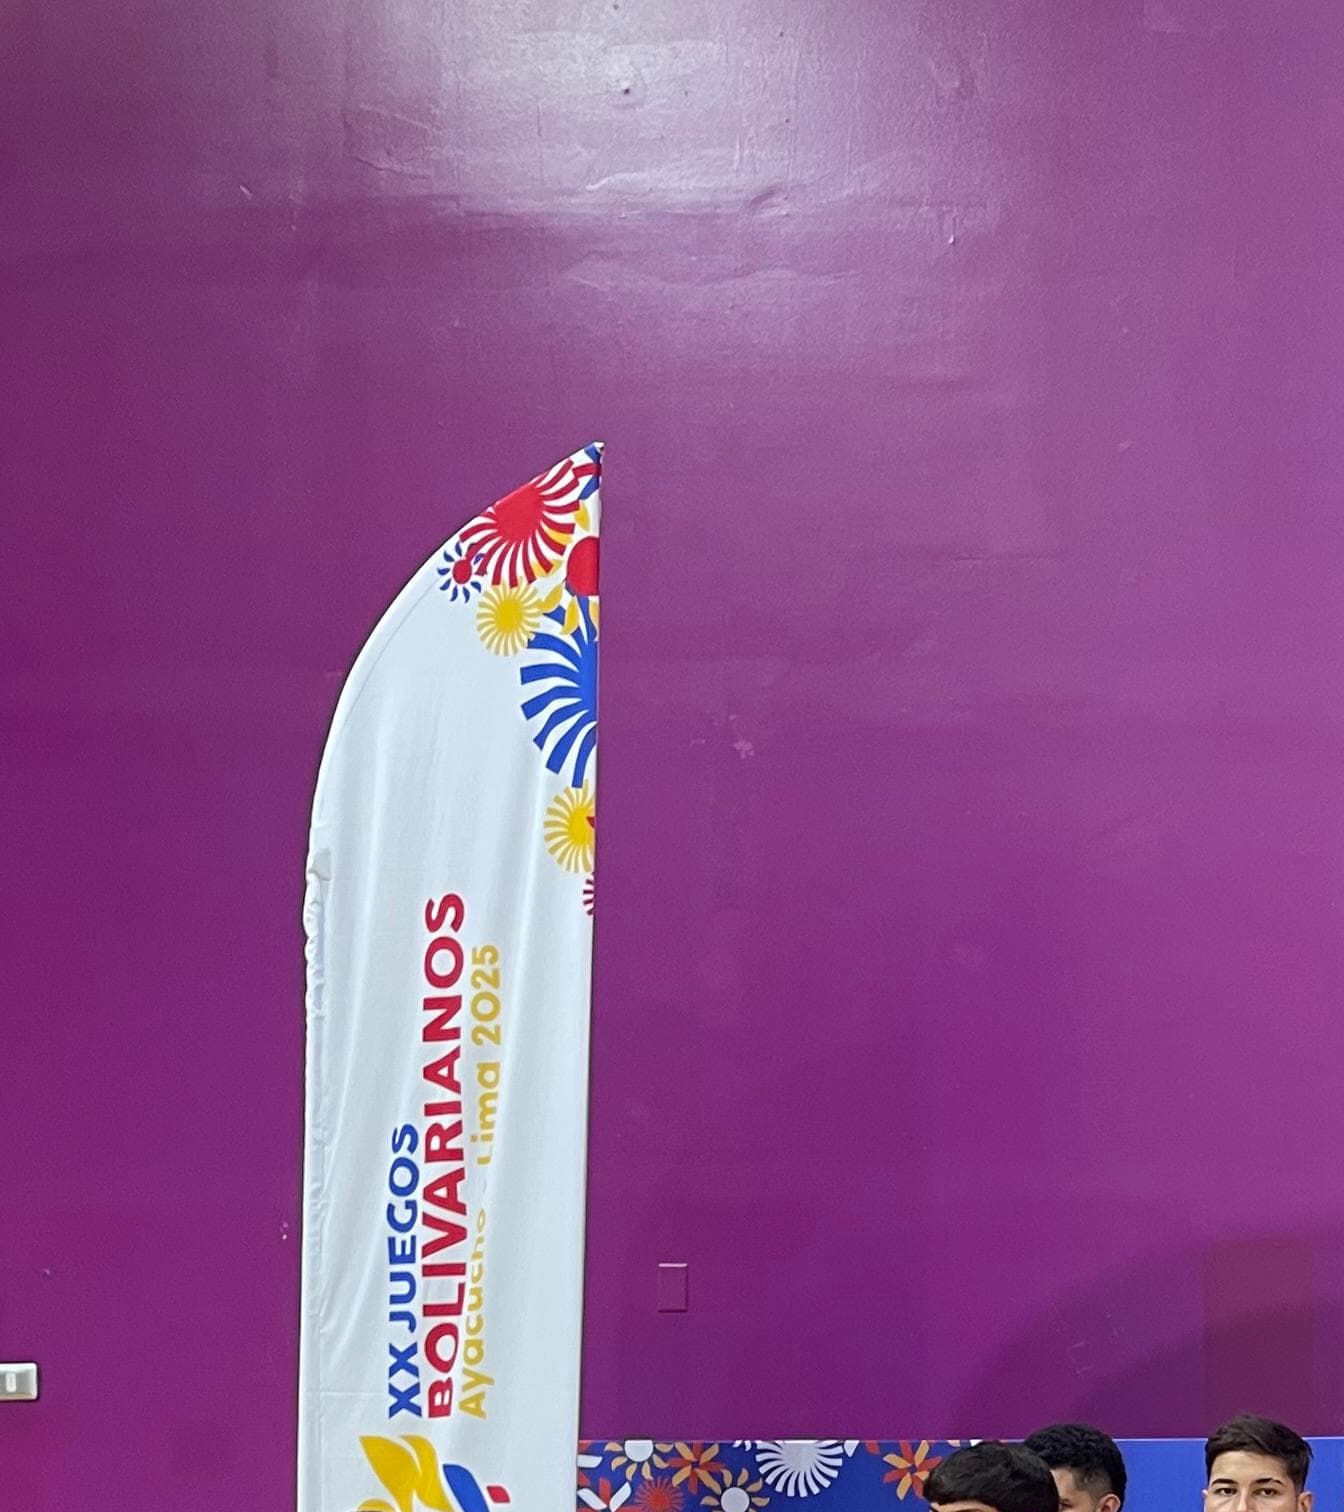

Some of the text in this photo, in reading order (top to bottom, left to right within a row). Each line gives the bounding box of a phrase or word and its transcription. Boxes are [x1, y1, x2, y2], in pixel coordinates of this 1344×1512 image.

[470, 944, 500, 1046] 2025
[421, 892, 468, 1418] BOLIVARIANOS
[470, 1062, 500, 1165] Lima
[387, 1123, 422, 1419] XX JUEGOS
